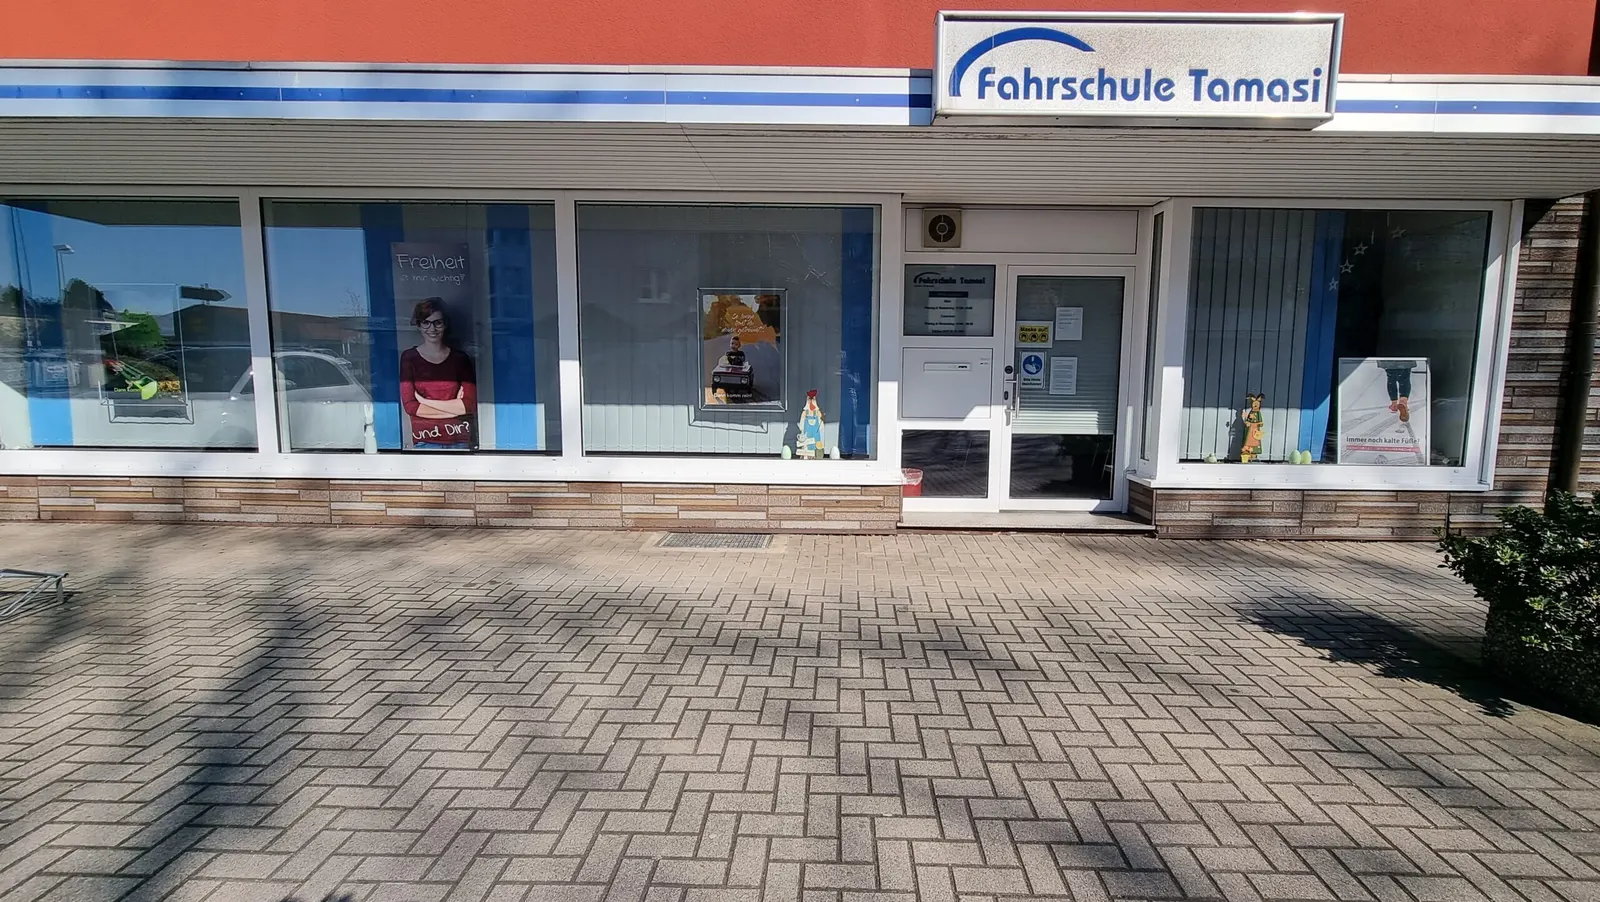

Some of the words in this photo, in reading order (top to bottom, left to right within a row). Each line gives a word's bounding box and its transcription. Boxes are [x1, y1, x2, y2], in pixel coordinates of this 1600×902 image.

[977, 67, 1176, 102] Fahrschule
[1188, 67, 1323, 104] Tamasi
[396, 253, 465, 269] Freiheit
[412, 426, 442, 440] und
[444, 421, 470, 436] Dir?
